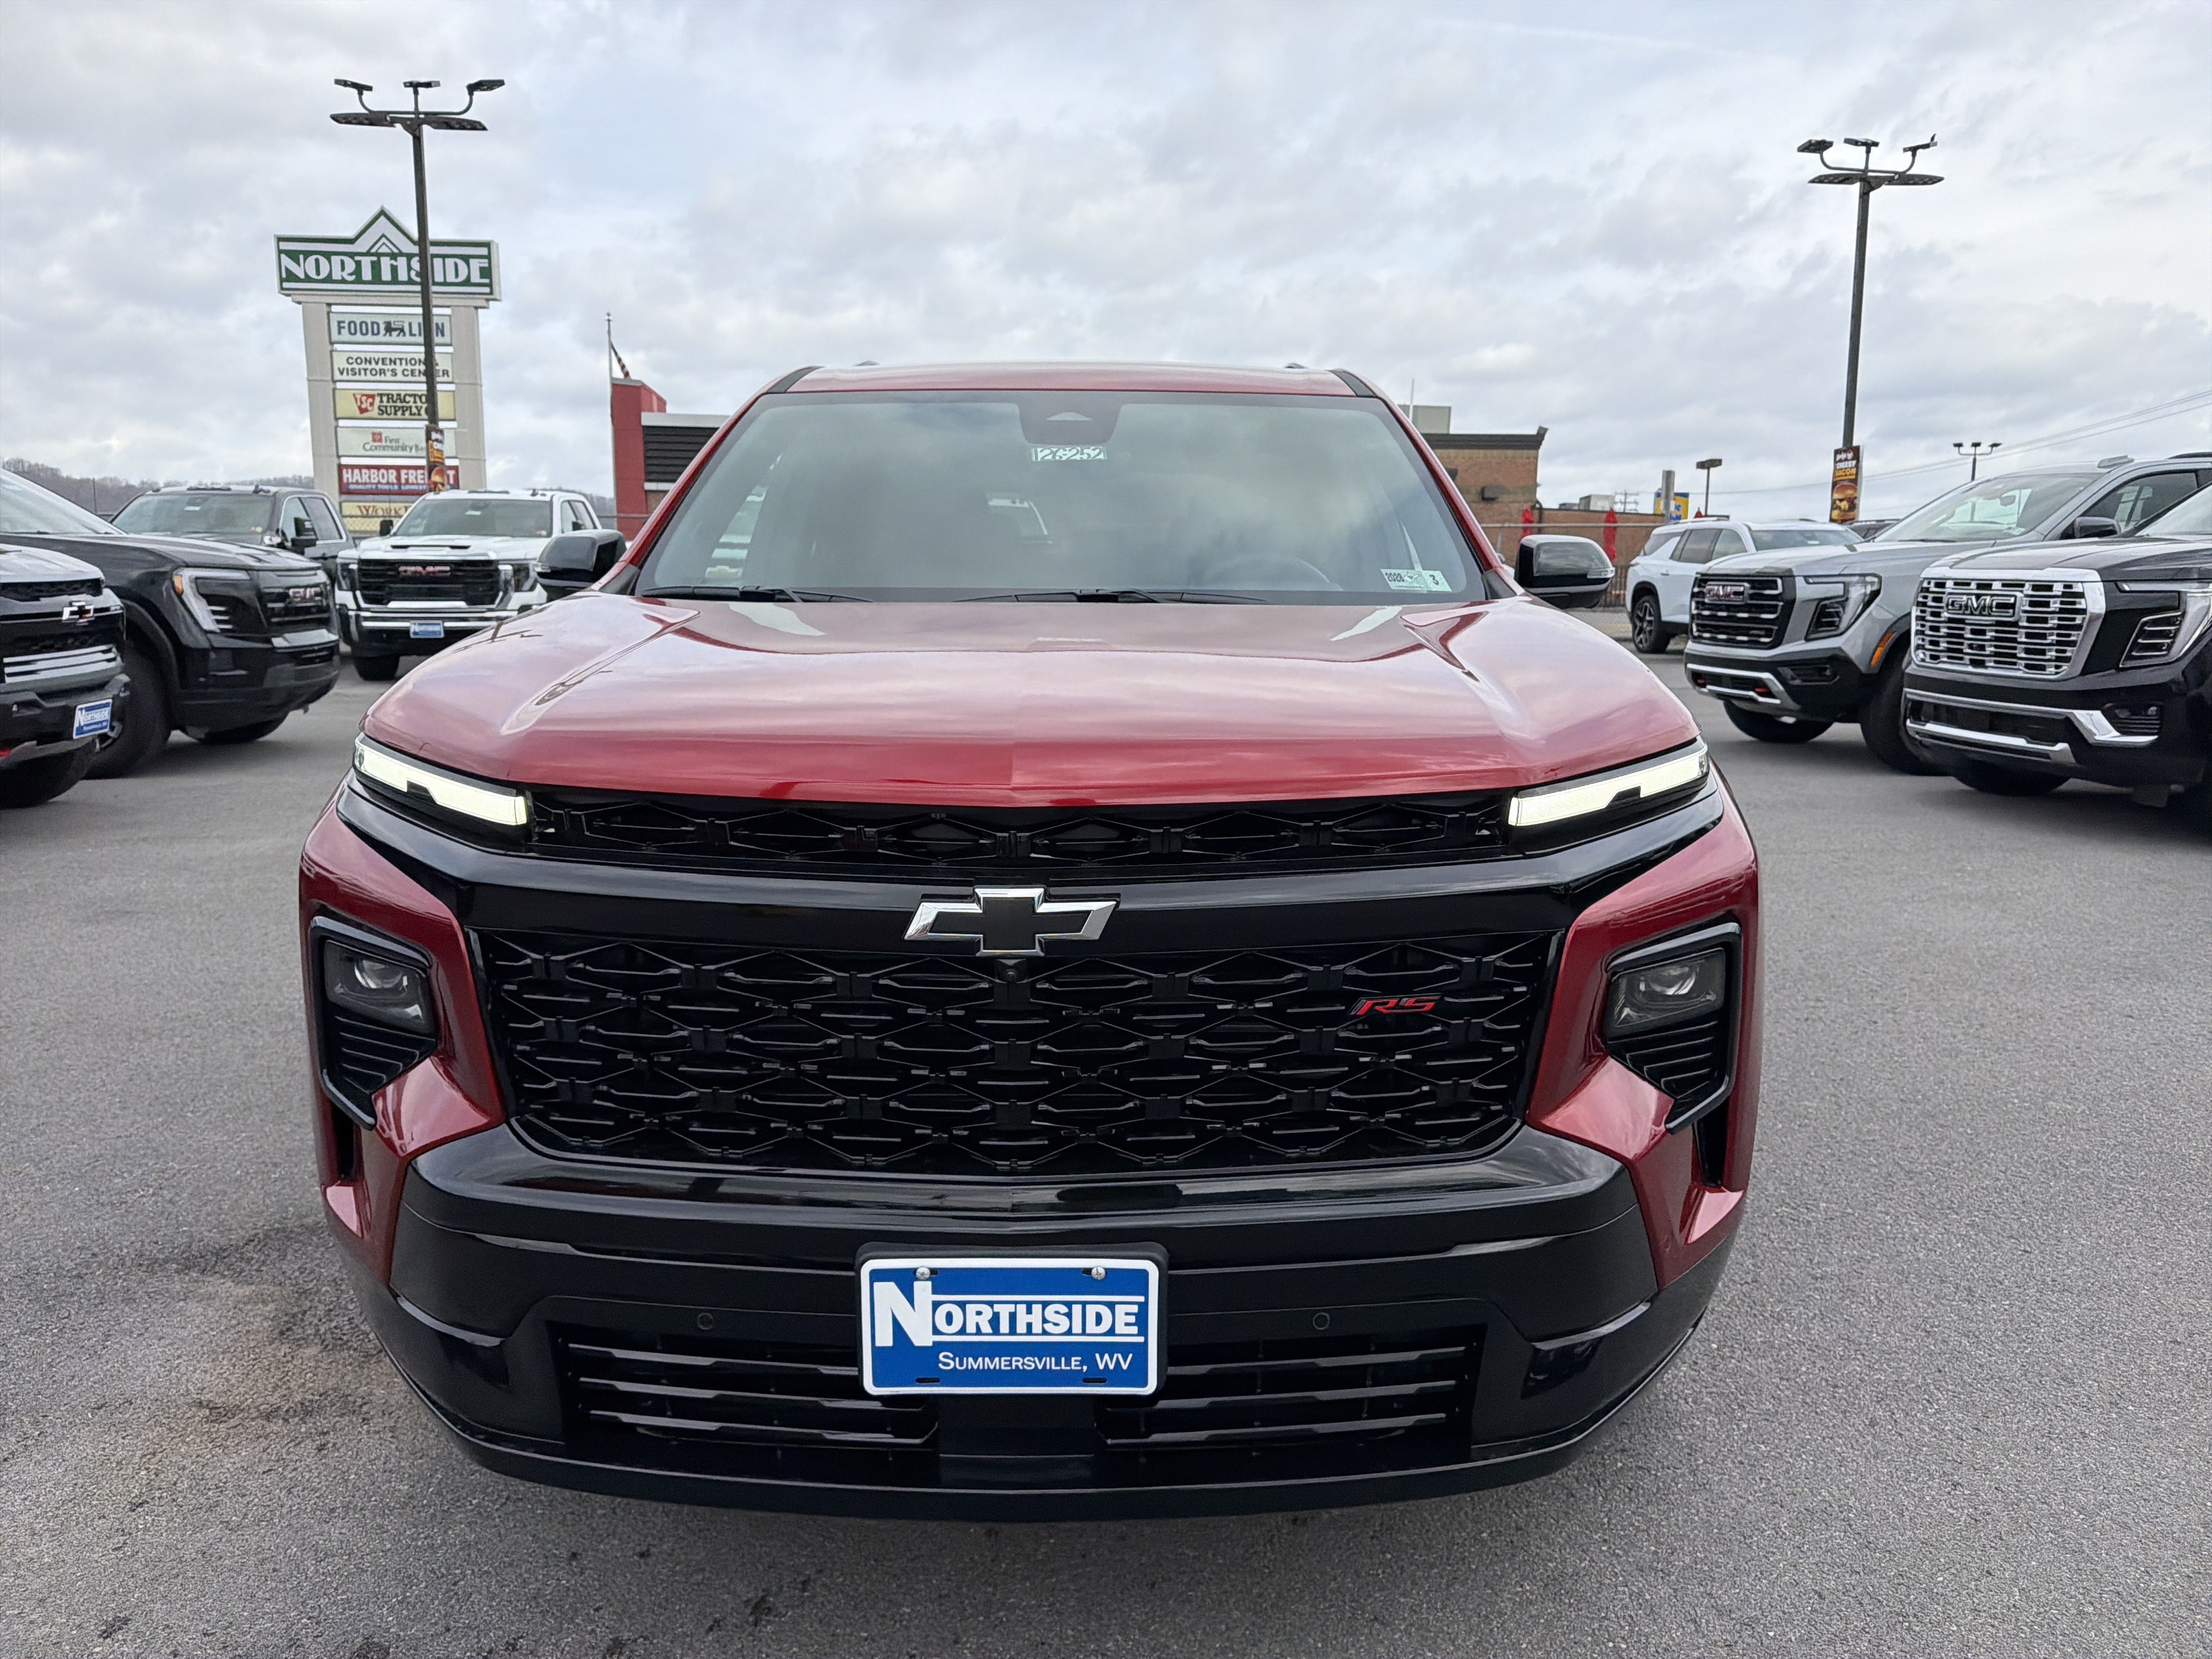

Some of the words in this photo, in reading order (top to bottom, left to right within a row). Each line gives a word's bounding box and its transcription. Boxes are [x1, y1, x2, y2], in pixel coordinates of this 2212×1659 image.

[280, 253, 489, 283] NORTHSIDE
[337, 320, 381, 336] FOOD
[408, 321, 445, 336] LIN
[346, 357, 426, 366] CONVENTION
[337, 367, 398, 377] VISITOR'S
[402, 368, 449, 377] CENER
[354, 393, 374, 411] TSC
[377, 393, 428, 404] TRACTO
[377, 405, 422, 416] SUPPLY
[363, 442, 413, 453] Community
[342, 469, 397, 483] HARBOR
[400, 469, 455, 484] FREIT
[1429, 574, 1440, 585] 3
[1947, 594, 2015, 616] GMC
[1350, 995, 1441, 1016] RS
[873, 1280, 1139, 1346] NORTHSIDE
[938, 1352, 1088, 1373] SUMMERSVILLE,
[1095, 1353, 1133, 1370] WV
